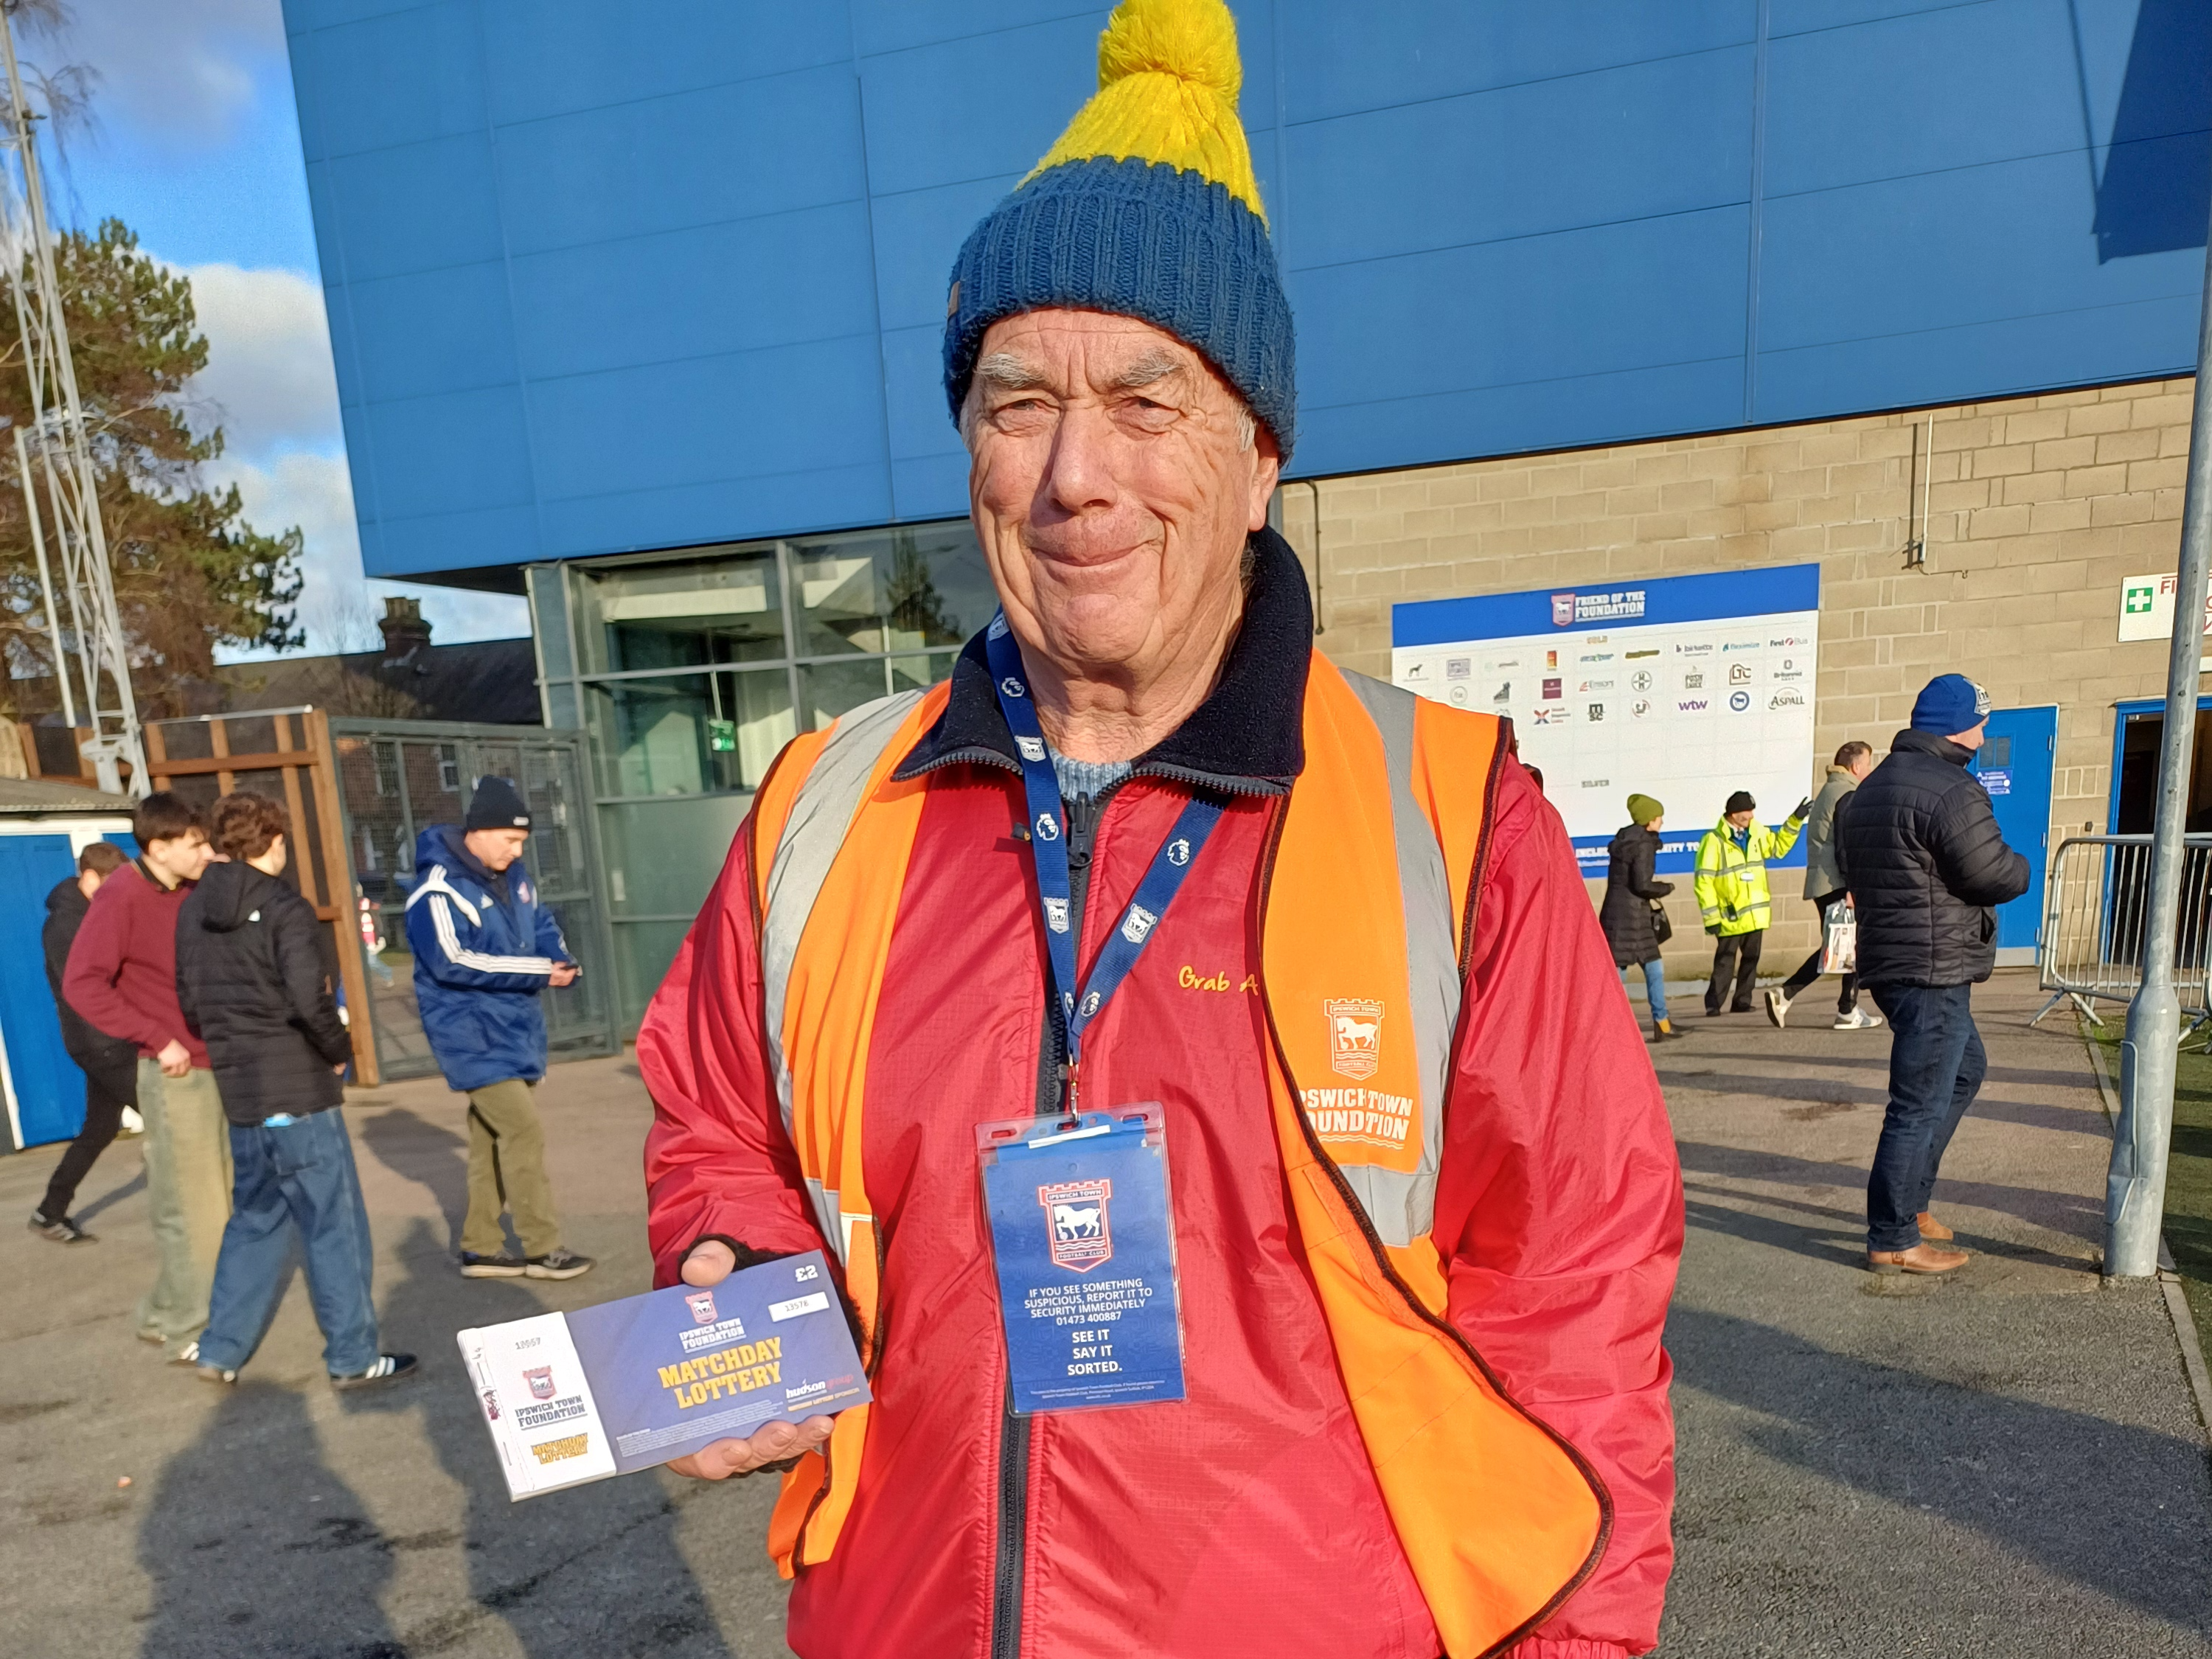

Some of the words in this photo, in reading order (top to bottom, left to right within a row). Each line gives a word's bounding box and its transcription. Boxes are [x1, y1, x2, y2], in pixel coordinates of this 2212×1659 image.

[1575, 594, 1610, 608] FRIEND
[1611, 592, 1624, 603] OF
[1625, 591, 1646, 602] THE
[1575, 601, 1646, 619] FOUNDATION
[1678, 700, 1708, 712] wtw
[1178, 964, 1231, 992] Grab
[1239, 973, 1259, 996] A
[1368, 1089, 1413, 1117] TOWN
[1048, 1192, 1078, 1200] IPSWICH
[1079, 1189, 1102, 1197] TOWN
[795, 1265, 818, 1282] £2
[1024, 1294, 1085, 1309] SUSPICIOUS,
[1086, 1290, 1125, 1302] REPORT
[1127, 1288, 1138, 1298] IT
[1139, 1287, 1152, 1297] TO
[1029, 1289, 1039, 1298] IF
[1040, 1287, 1061, 1297] YOU
[1063, 1284, 1080, 1295] SEE
[1082, 1278, 1143, 1293] SOMETHING
[1031, 1305, 1077, 1318] SECURITY
[1079, 1298, 1146, 1314] IMMEDIATELY
[1056, 1315, 1085, 1326] 01473
[1087, 1311, 1121, 1323] 400887
[679, 1324, 716, 1341] IPSWICH
[681, 1326, 745, 1350] FOUNDATION
[1072, 1330, 1095, 1343] SEE
[1097, 1329, 1110, 1341] IT
[657, 1336, 783, 1388] MATCHDAY
[1073, 1346, 1098, 1359] SAY
[1100, 1345, 1113, 1357] IT
[1068, 1360, 1123, 1377] SORTED.
[673, 1360, 782, 1410] LOTTERY
[786, 1378, 826, 1399] hudson
[515, 1402, 554, 1418] IPSWICH
[555, 1394, 582, 1409] TOWN
[518, 1403, 585, 1427] FOUNDATION
